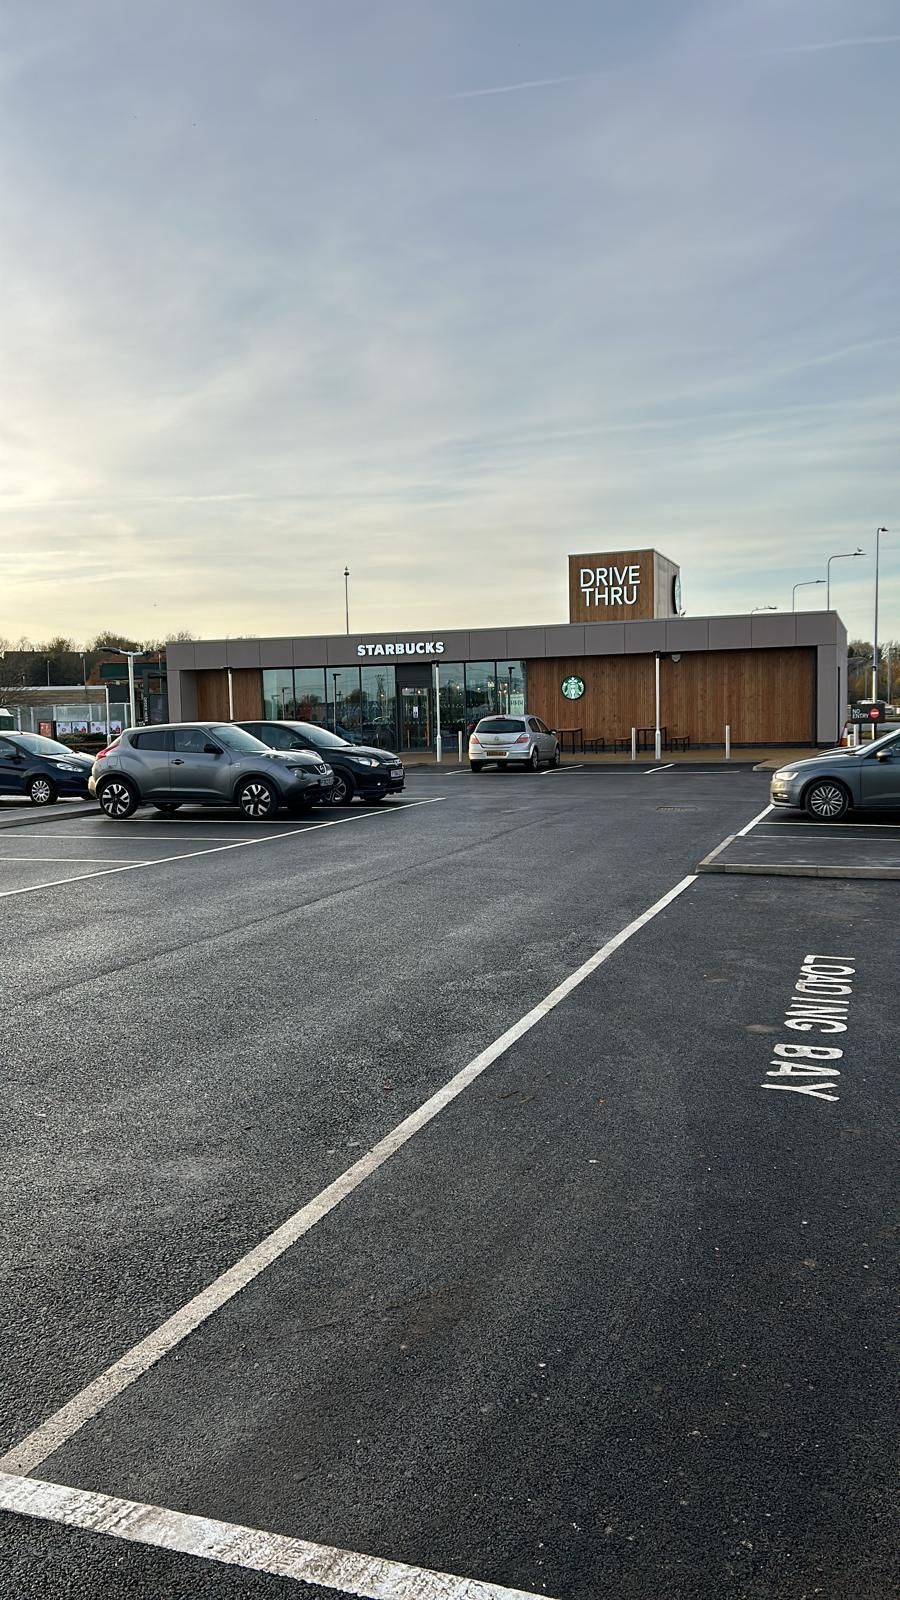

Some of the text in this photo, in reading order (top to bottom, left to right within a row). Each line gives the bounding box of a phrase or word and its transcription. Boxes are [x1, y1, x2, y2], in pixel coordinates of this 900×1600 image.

[580, 565, 641, 587] DRIVE
[581, 586, 637, 607] THRU
[357, 641, 444, 656] STARBUCKS
[760, 954, 856, 1102] LOADING BAY
